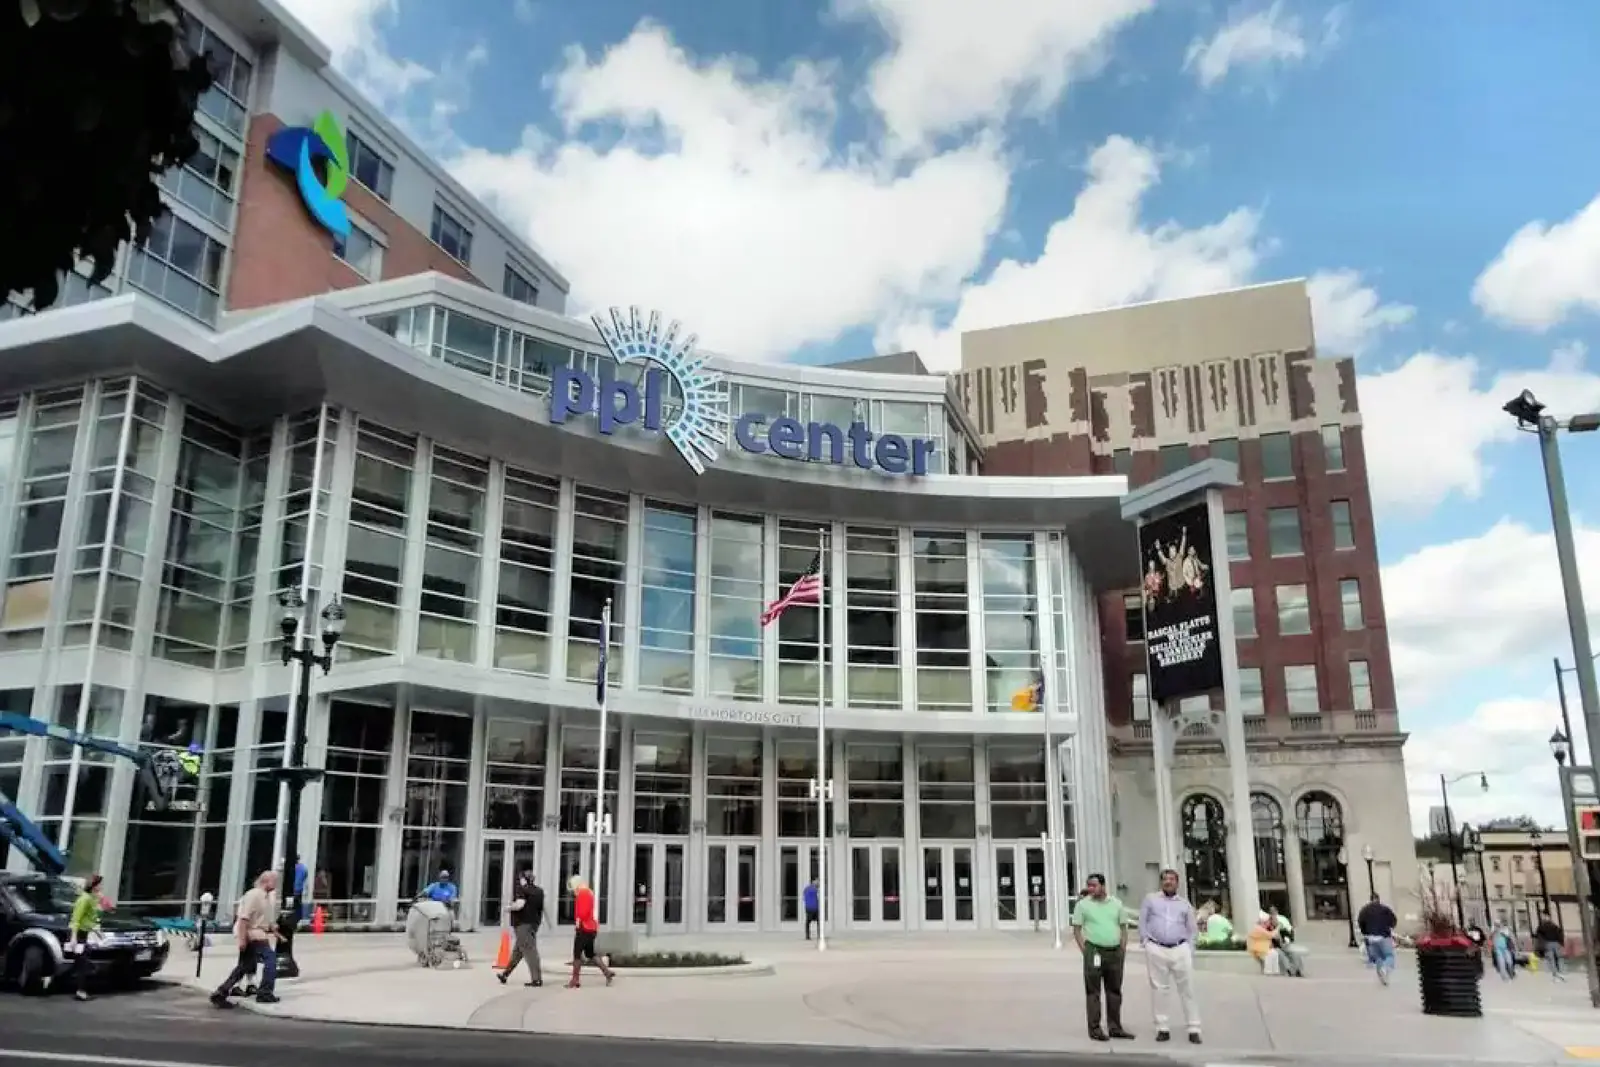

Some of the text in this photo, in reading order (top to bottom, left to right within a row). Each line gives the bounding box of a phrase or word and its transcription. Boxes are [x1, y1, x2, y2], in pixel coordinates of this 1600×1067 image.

[549, 364, 935, 476] ppl center
[1179, 615, 1210, 631] FLATTS
